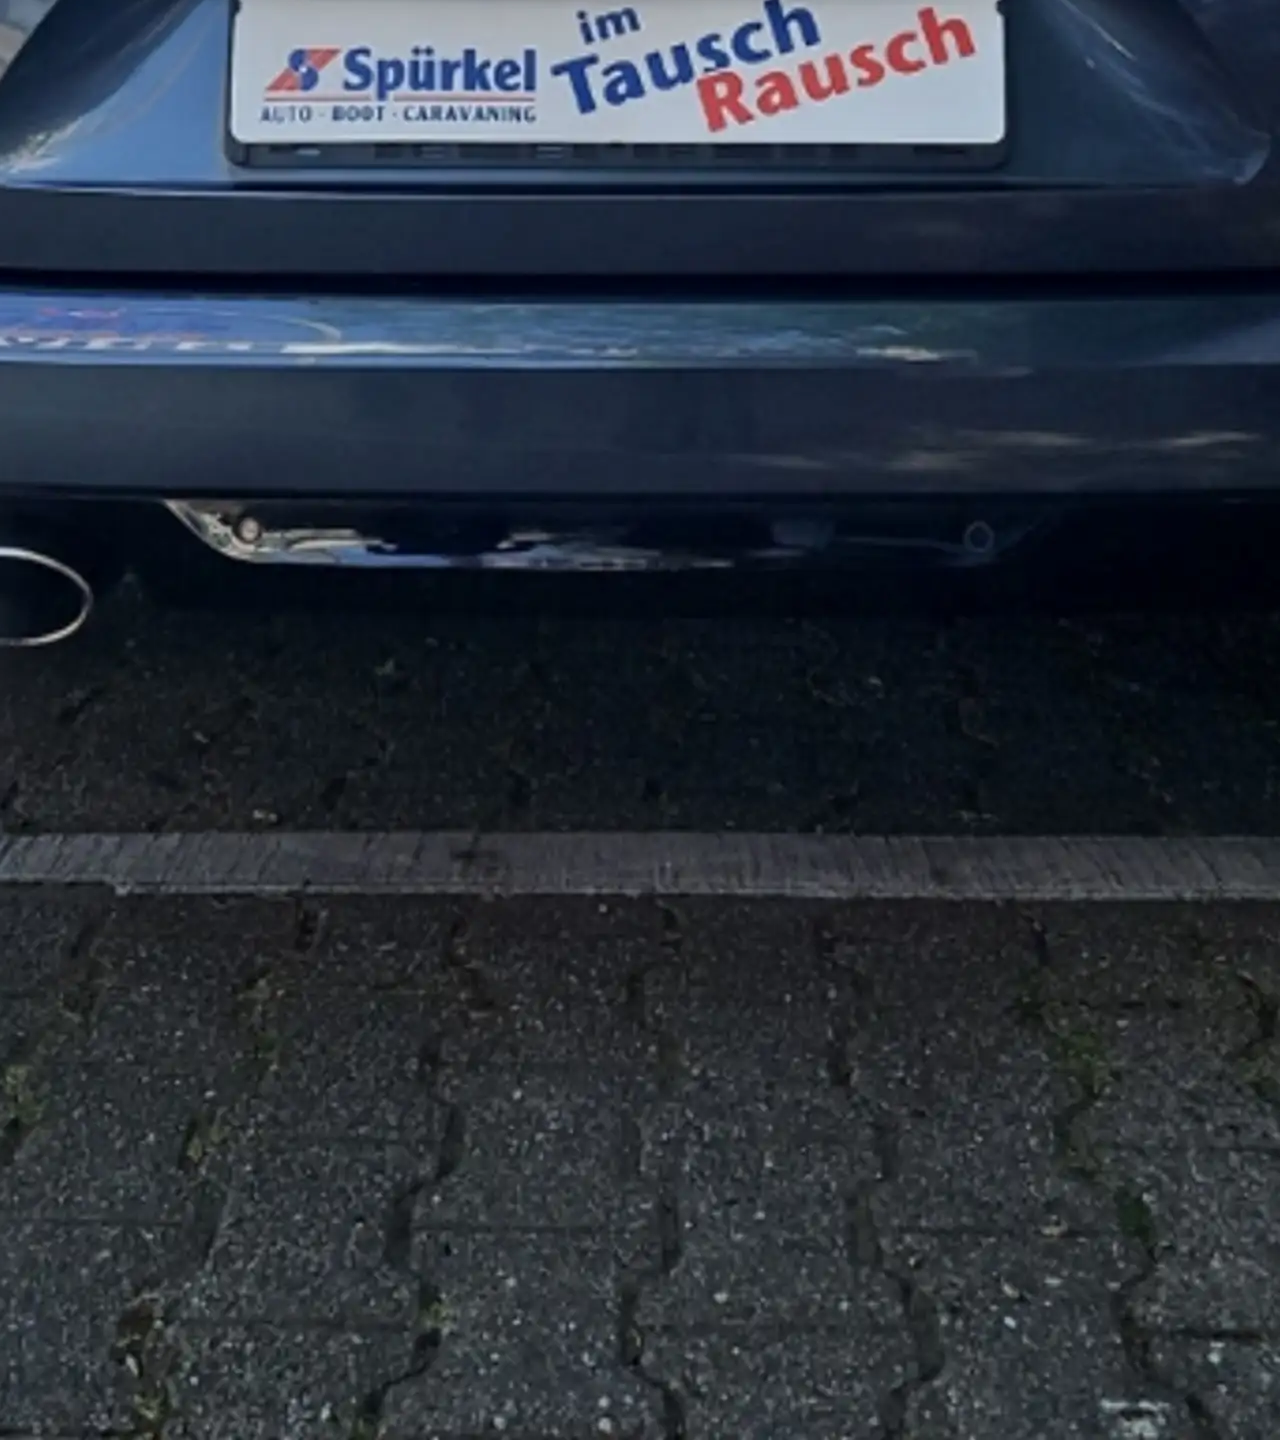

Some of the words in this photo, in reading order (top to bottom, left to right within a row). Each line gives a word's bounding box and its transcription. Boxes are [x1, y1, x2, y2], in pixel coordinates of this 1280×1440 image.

[577, 7, 641, 45] im
[343, 46, 537, 101] Spürkel
[696, 6, 977, 133] Rausch
[260, 105, 312, 123] AUTO
[331, 105, 386, 122] BOOT
[403, 105, 537, 123] CARAVANING
